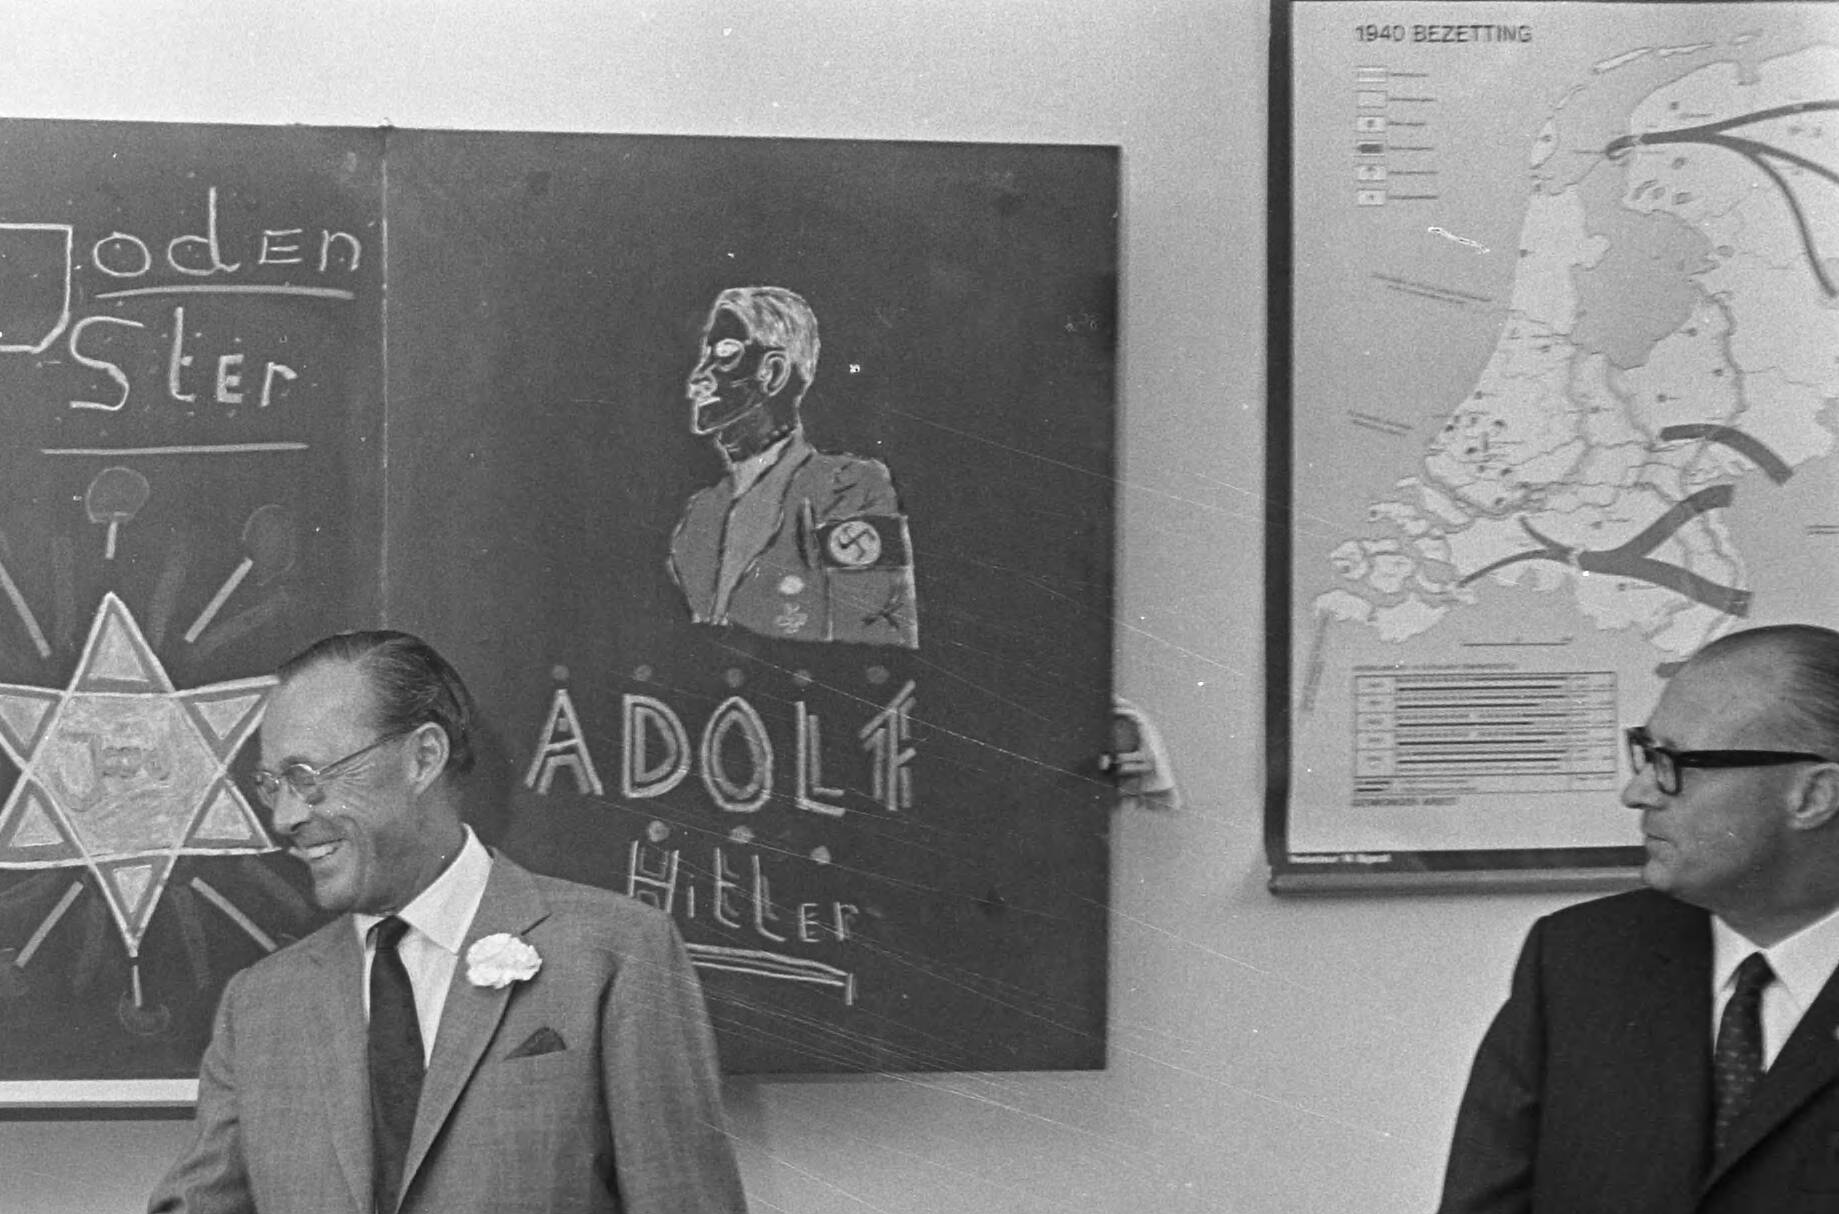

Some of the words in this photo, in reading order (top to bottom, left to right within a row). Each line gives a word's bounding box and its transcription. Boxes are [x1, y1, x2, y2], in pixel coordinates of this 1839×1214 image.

[1355, 24, 1406, 43] 1940
[1413, 24, 1533, 43] BEZETTING
[523, 679, 917, 817] ADOLF
